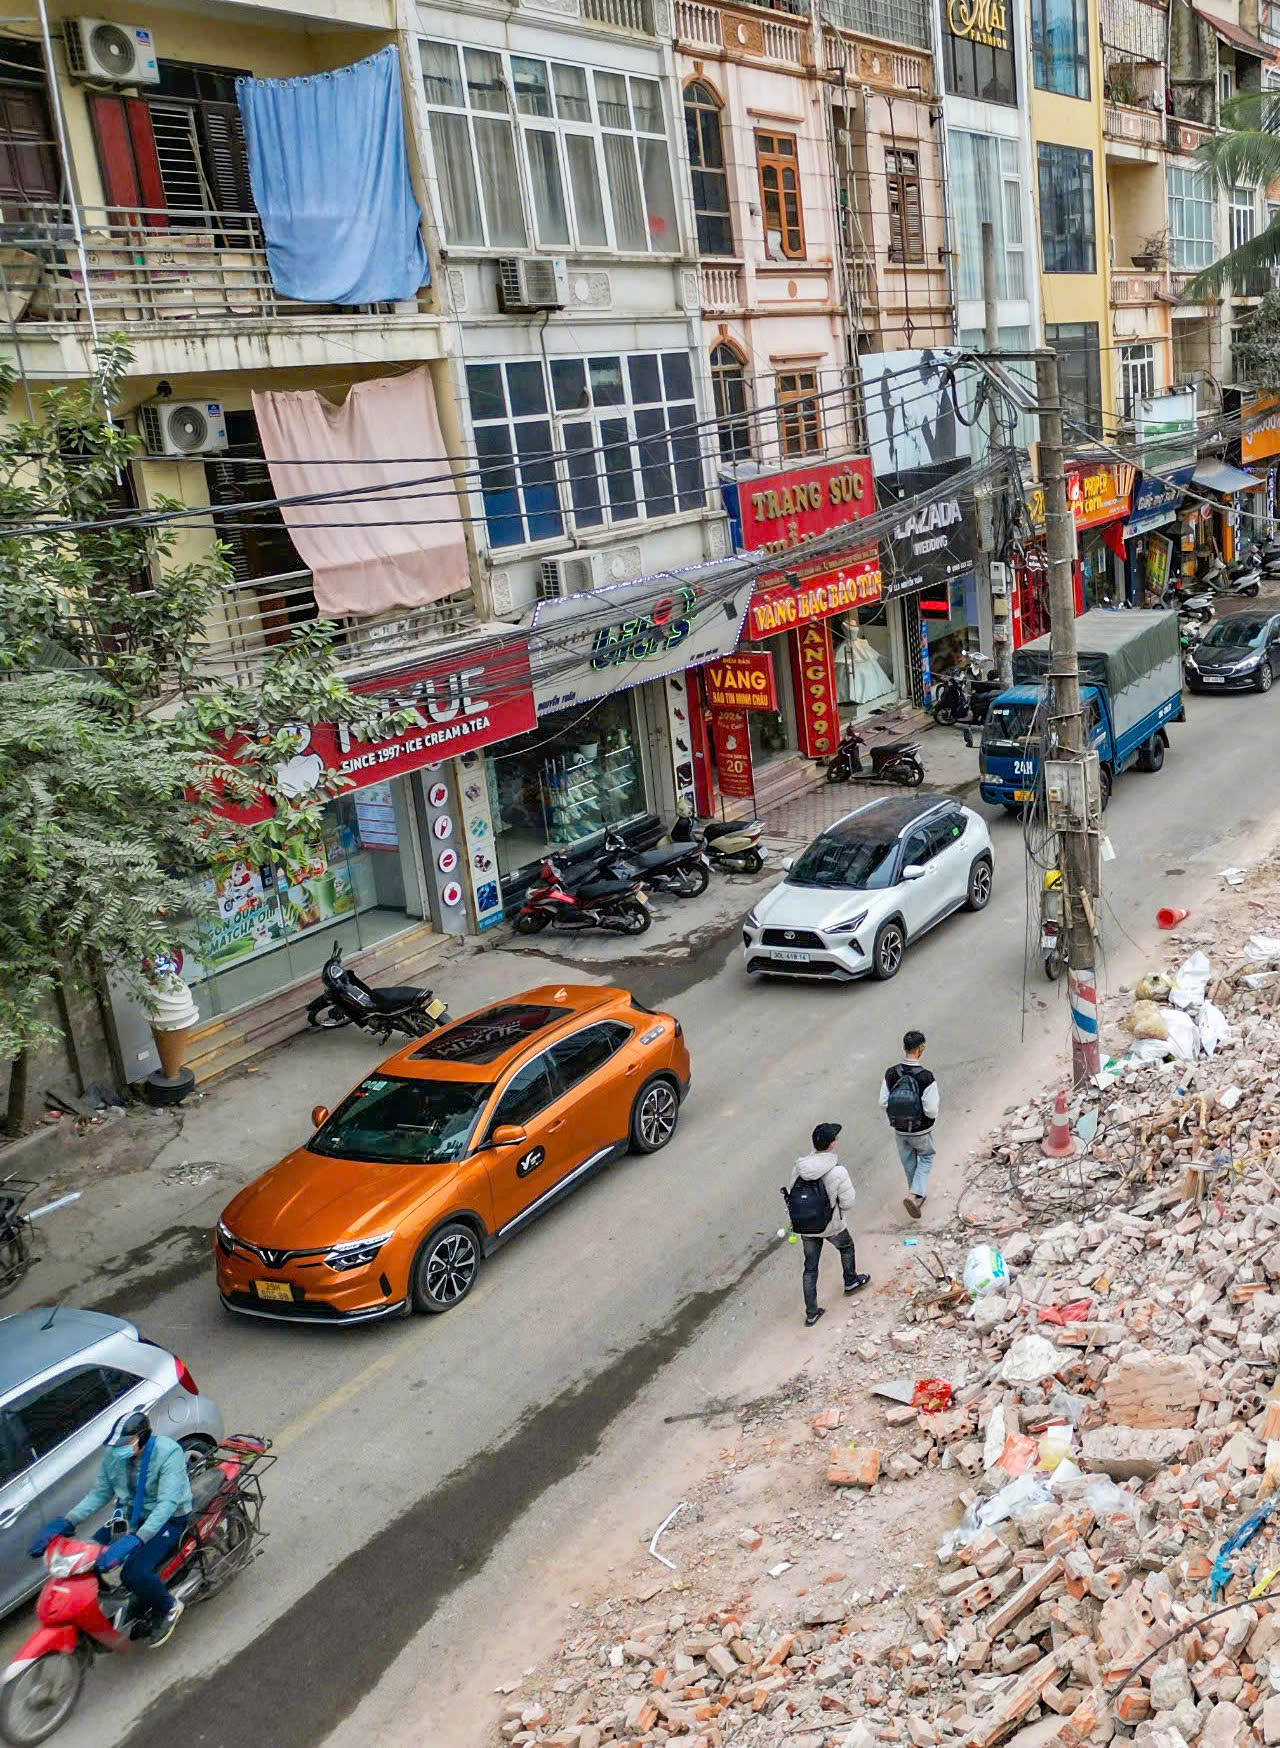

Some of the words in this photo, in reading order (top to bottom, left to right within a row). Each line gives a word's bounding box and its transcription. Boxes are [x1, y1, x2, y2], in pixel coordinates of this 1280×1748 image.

[971, 29, 1008, 50] FASHION
[752, 481, 822, 522] TRANG
[894, 498, 962, 540] LAZADA
[913, 535, 948, 556] WEDDING
[753, 594, 797, 631] VÀNG
[710, 664, 767, 690] VÀNG
[341, 751, 376, 773] SINCE
[405, 737, 423, 754] ICE
[1013, 760, 1034, 775] 24H
[209, 918, 255, 952] MATCHA
